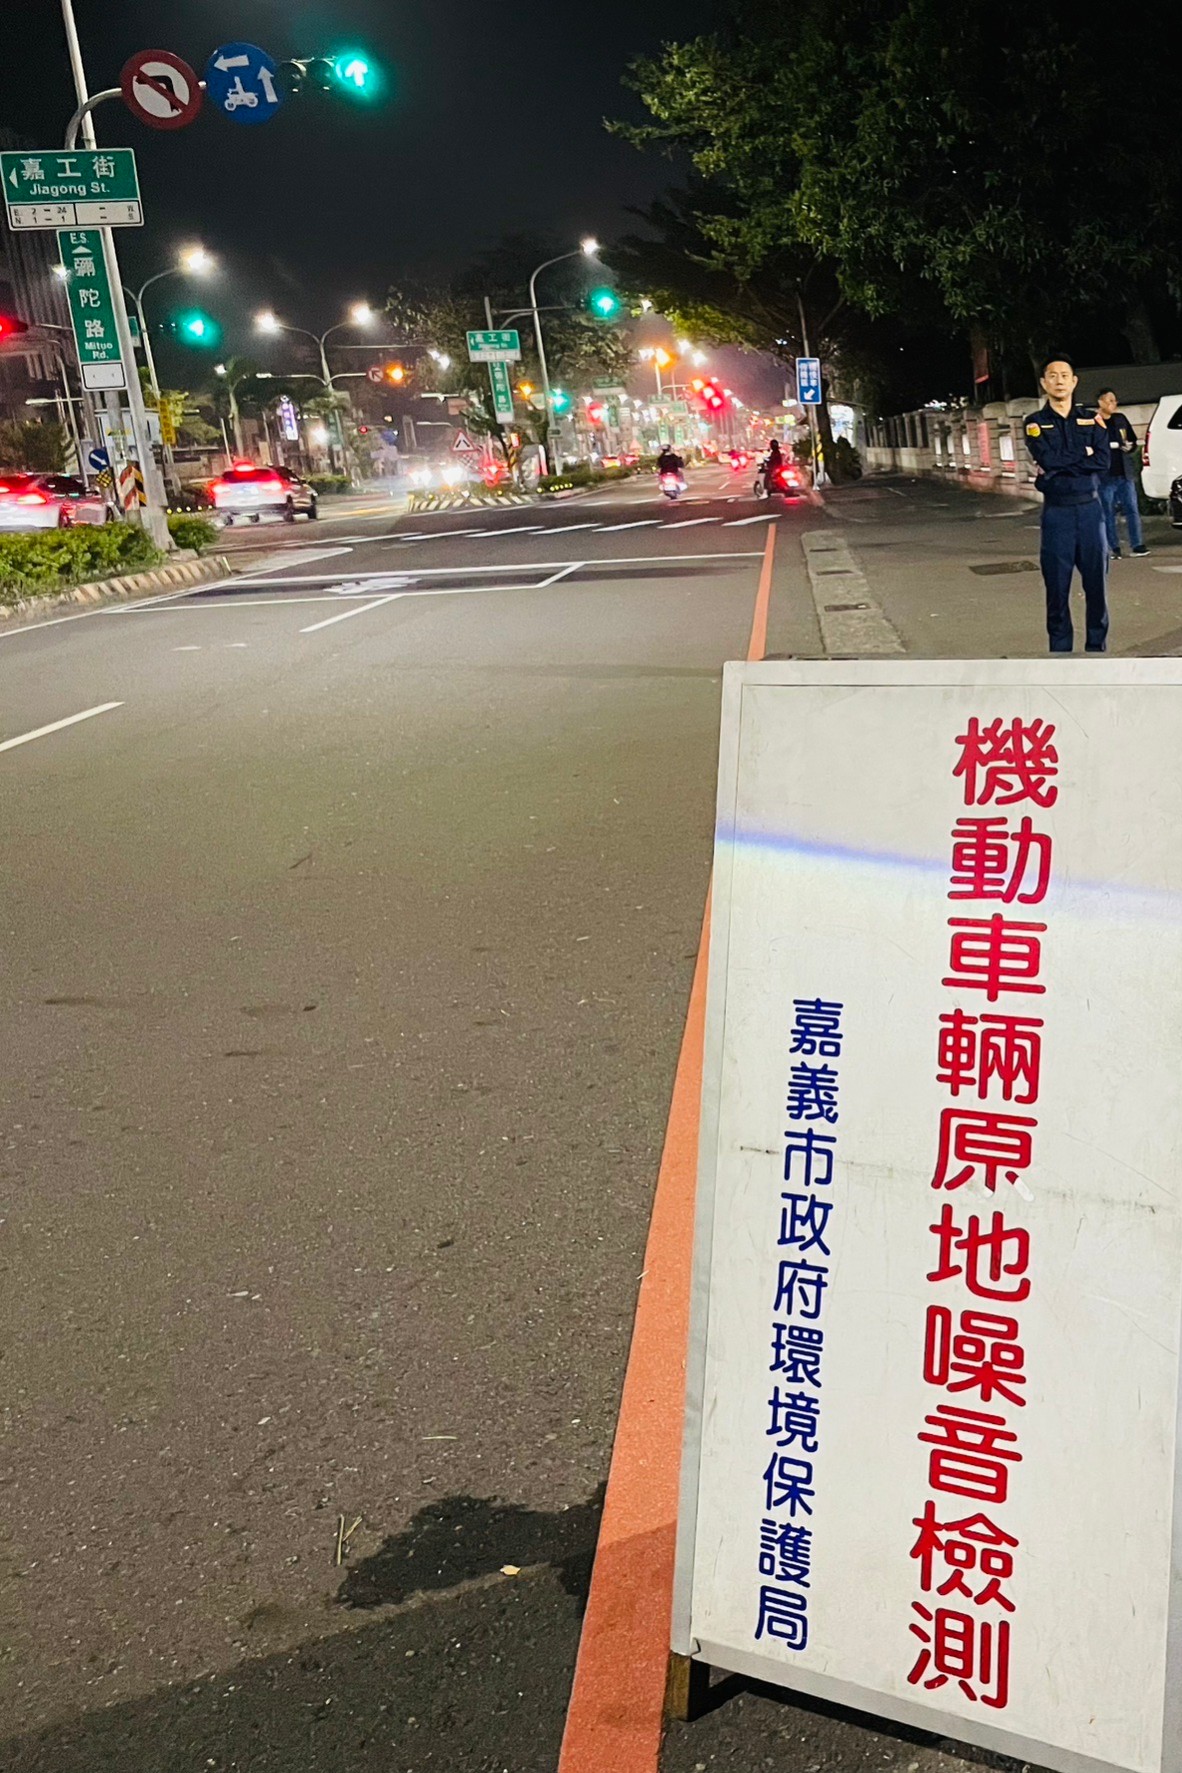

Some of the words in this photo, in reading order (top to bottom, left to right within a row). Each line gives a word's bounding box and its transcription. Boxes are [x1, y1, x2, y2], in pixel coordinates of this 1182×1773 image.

[20, 155, 115, 180] 嘉工街
[30, 182, 87, 197] Jiagong
[90, 181, 110, 194] St.
[92, 350, 109, 359] Rd.
[908, 717, 1059, 1710] 機動車輛原地噪音檢測
[756, 997, 843, 1652] 嘉義市政府環境保護局
